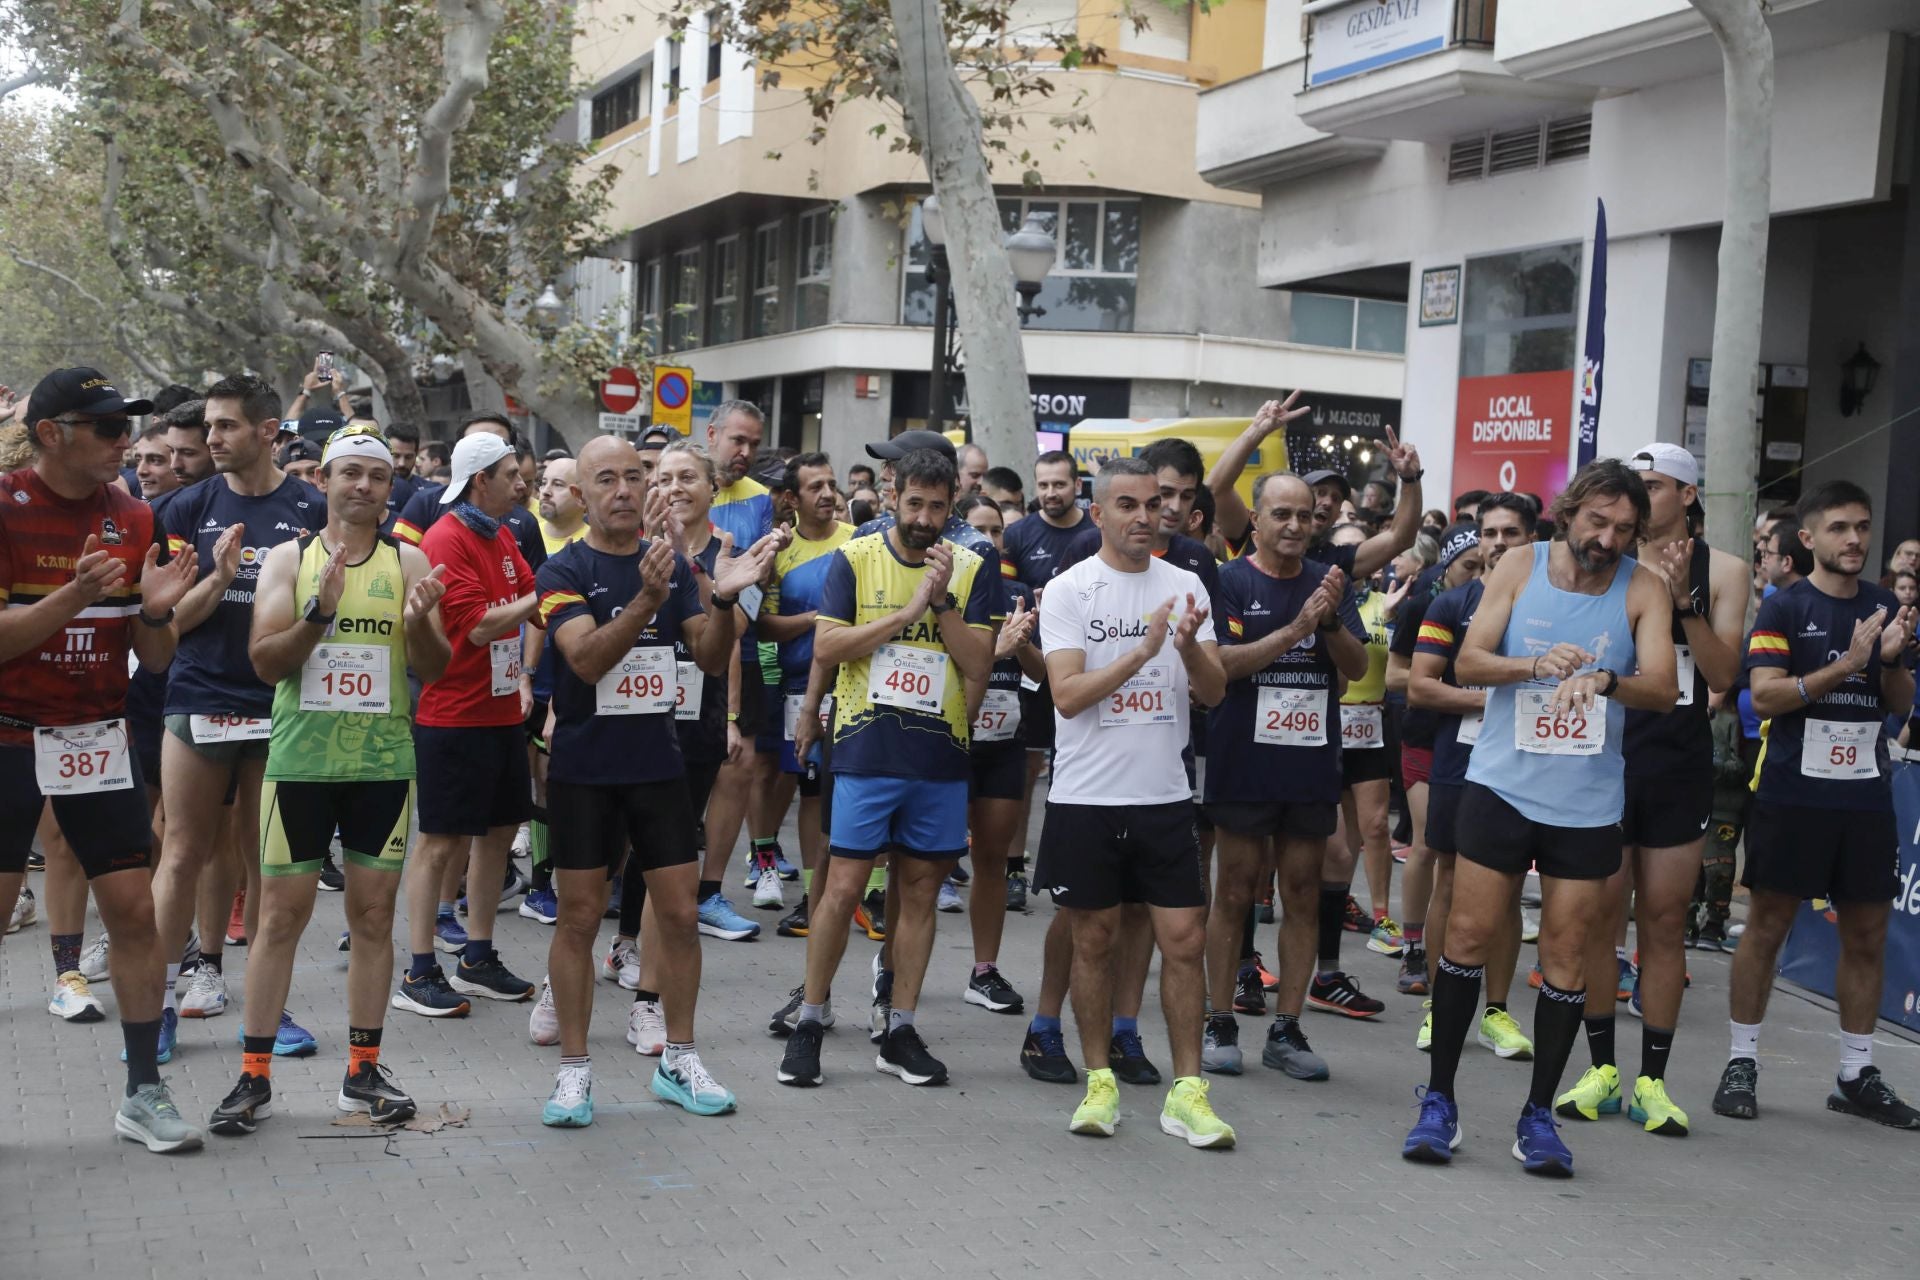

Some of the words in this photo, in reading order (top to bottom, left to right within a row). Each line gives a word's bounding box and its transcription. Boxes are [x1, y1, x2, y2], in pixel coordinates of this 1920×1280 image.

[1347, 0, 1420, 38] GESDENIA
[1328, 409, 1381, 427] MACSON
[1489, 395, 1533, 418] LOCAL
[1472, 418, 1552, 442] DISPONIBLE
[1441, 529, 1477, 561] BASX
[40, 651, 109, 662] MARTINEZ
[505, 661, 521, 681] 46
[885, 669, 930, 696] 480
[321, 671, 372, 697] 150
[616, 673, 663, 698] 499
[1111, 690, 1163, 714] 3401
[1266, 710, 1320, 732] 2496
[1342, 723, 1374, 739] 430
[1536, 716, 1587, 739] 562
[59, 749, 111, 778] 387
[1830, 745, 1857, 766] 59
